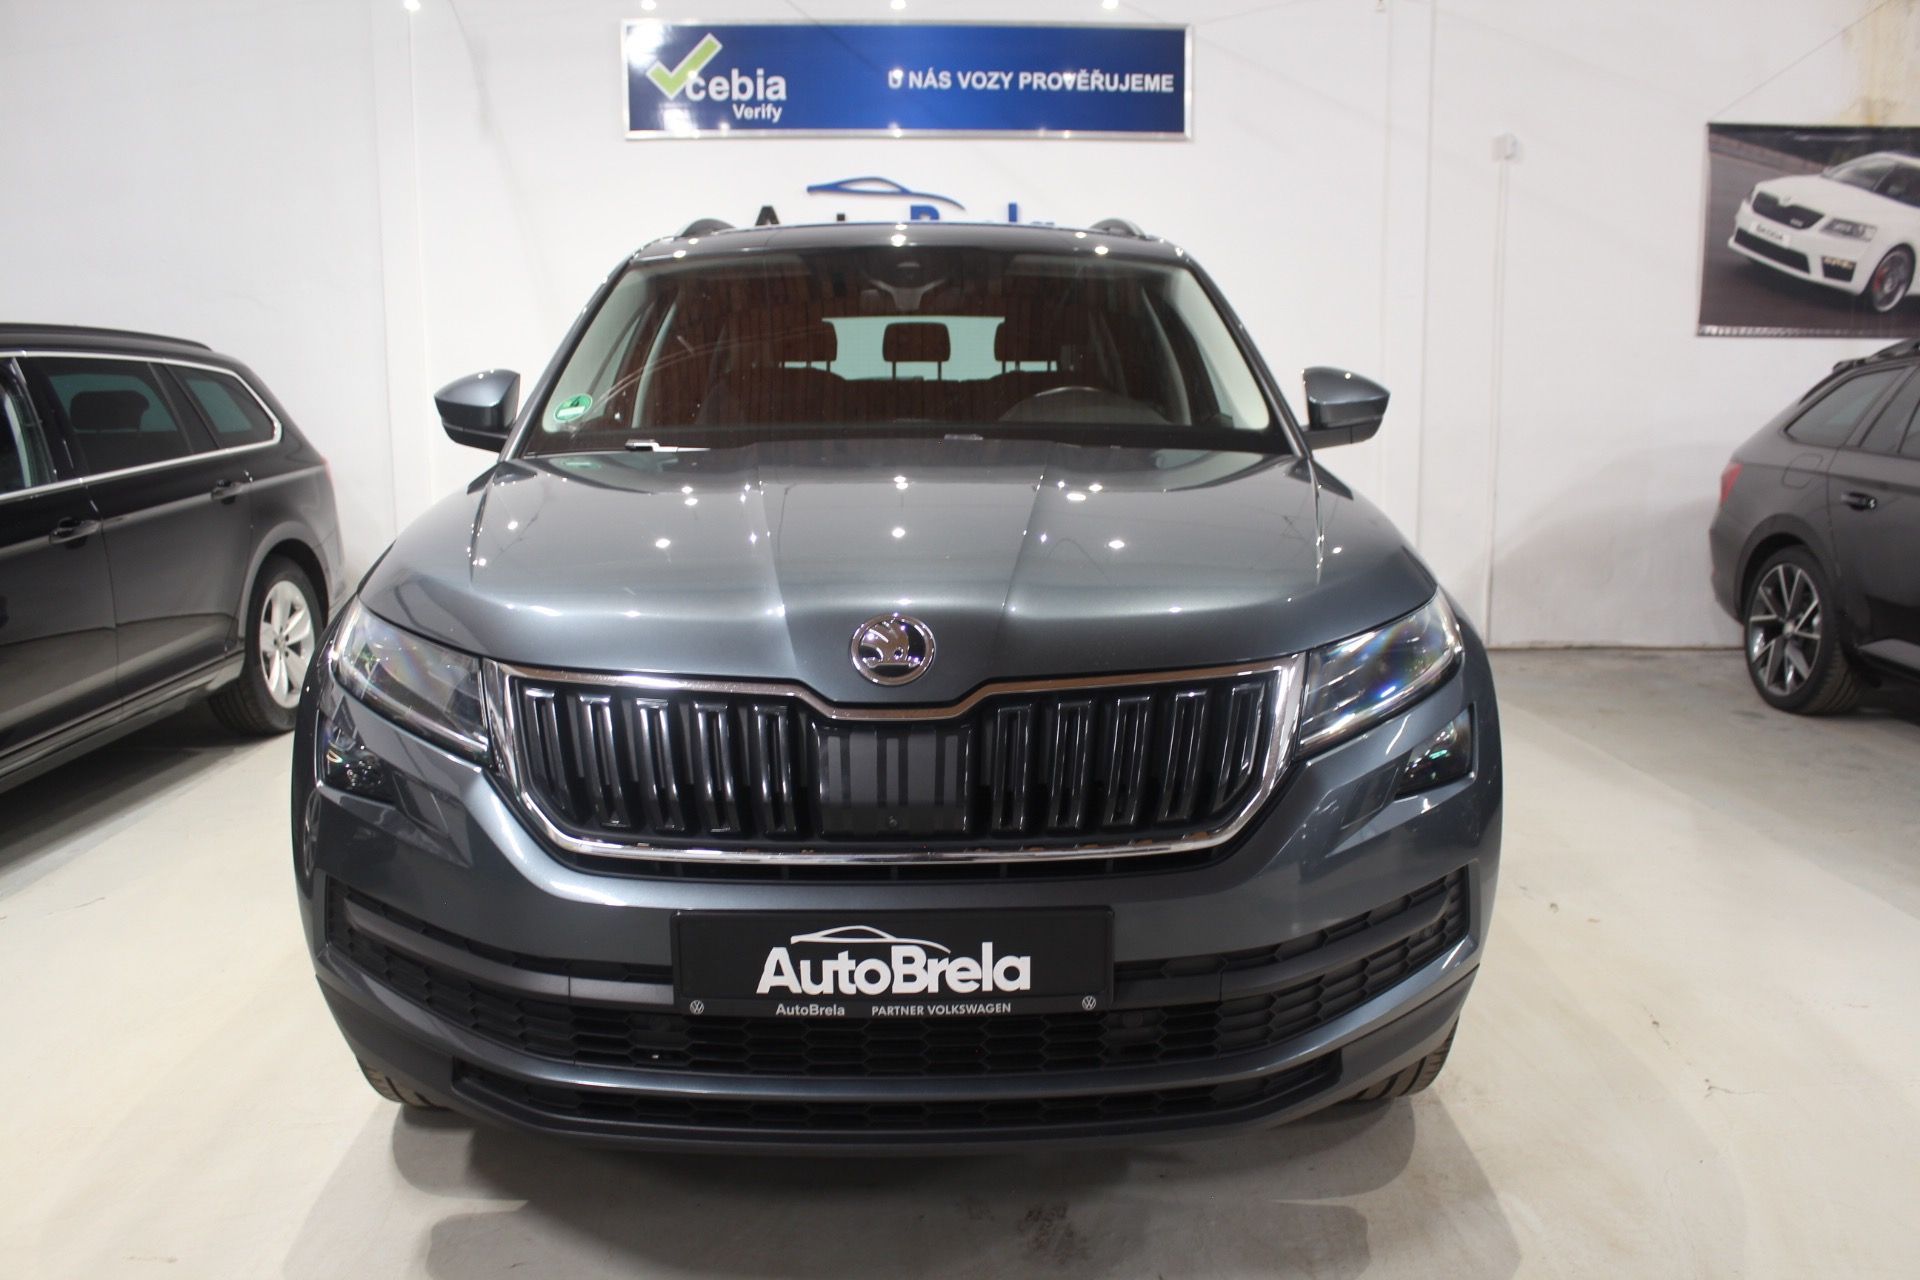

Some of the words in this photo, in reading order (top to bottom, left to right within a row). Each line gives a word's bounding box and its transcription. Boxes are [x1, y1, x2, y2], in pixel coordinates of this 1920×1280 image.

[685, 68, 787, 101] cebia
[888, 69, 904, 89] U
[909, 67, 952, 89] NÁS
[957, 71, 1014, 90] VOZY
[1019, 69, 1174, 92] PROVĚŘUJEME
[732, 103, 782, 123] Verify
[756, 941, 1031, 995] AutoBrela
[775, 1003, 845, 1016] AutoBrela
[871, 1004, 925, 1016] PARTNER
[927, 1002, 1012, 1015] VOLKSWAGEN
